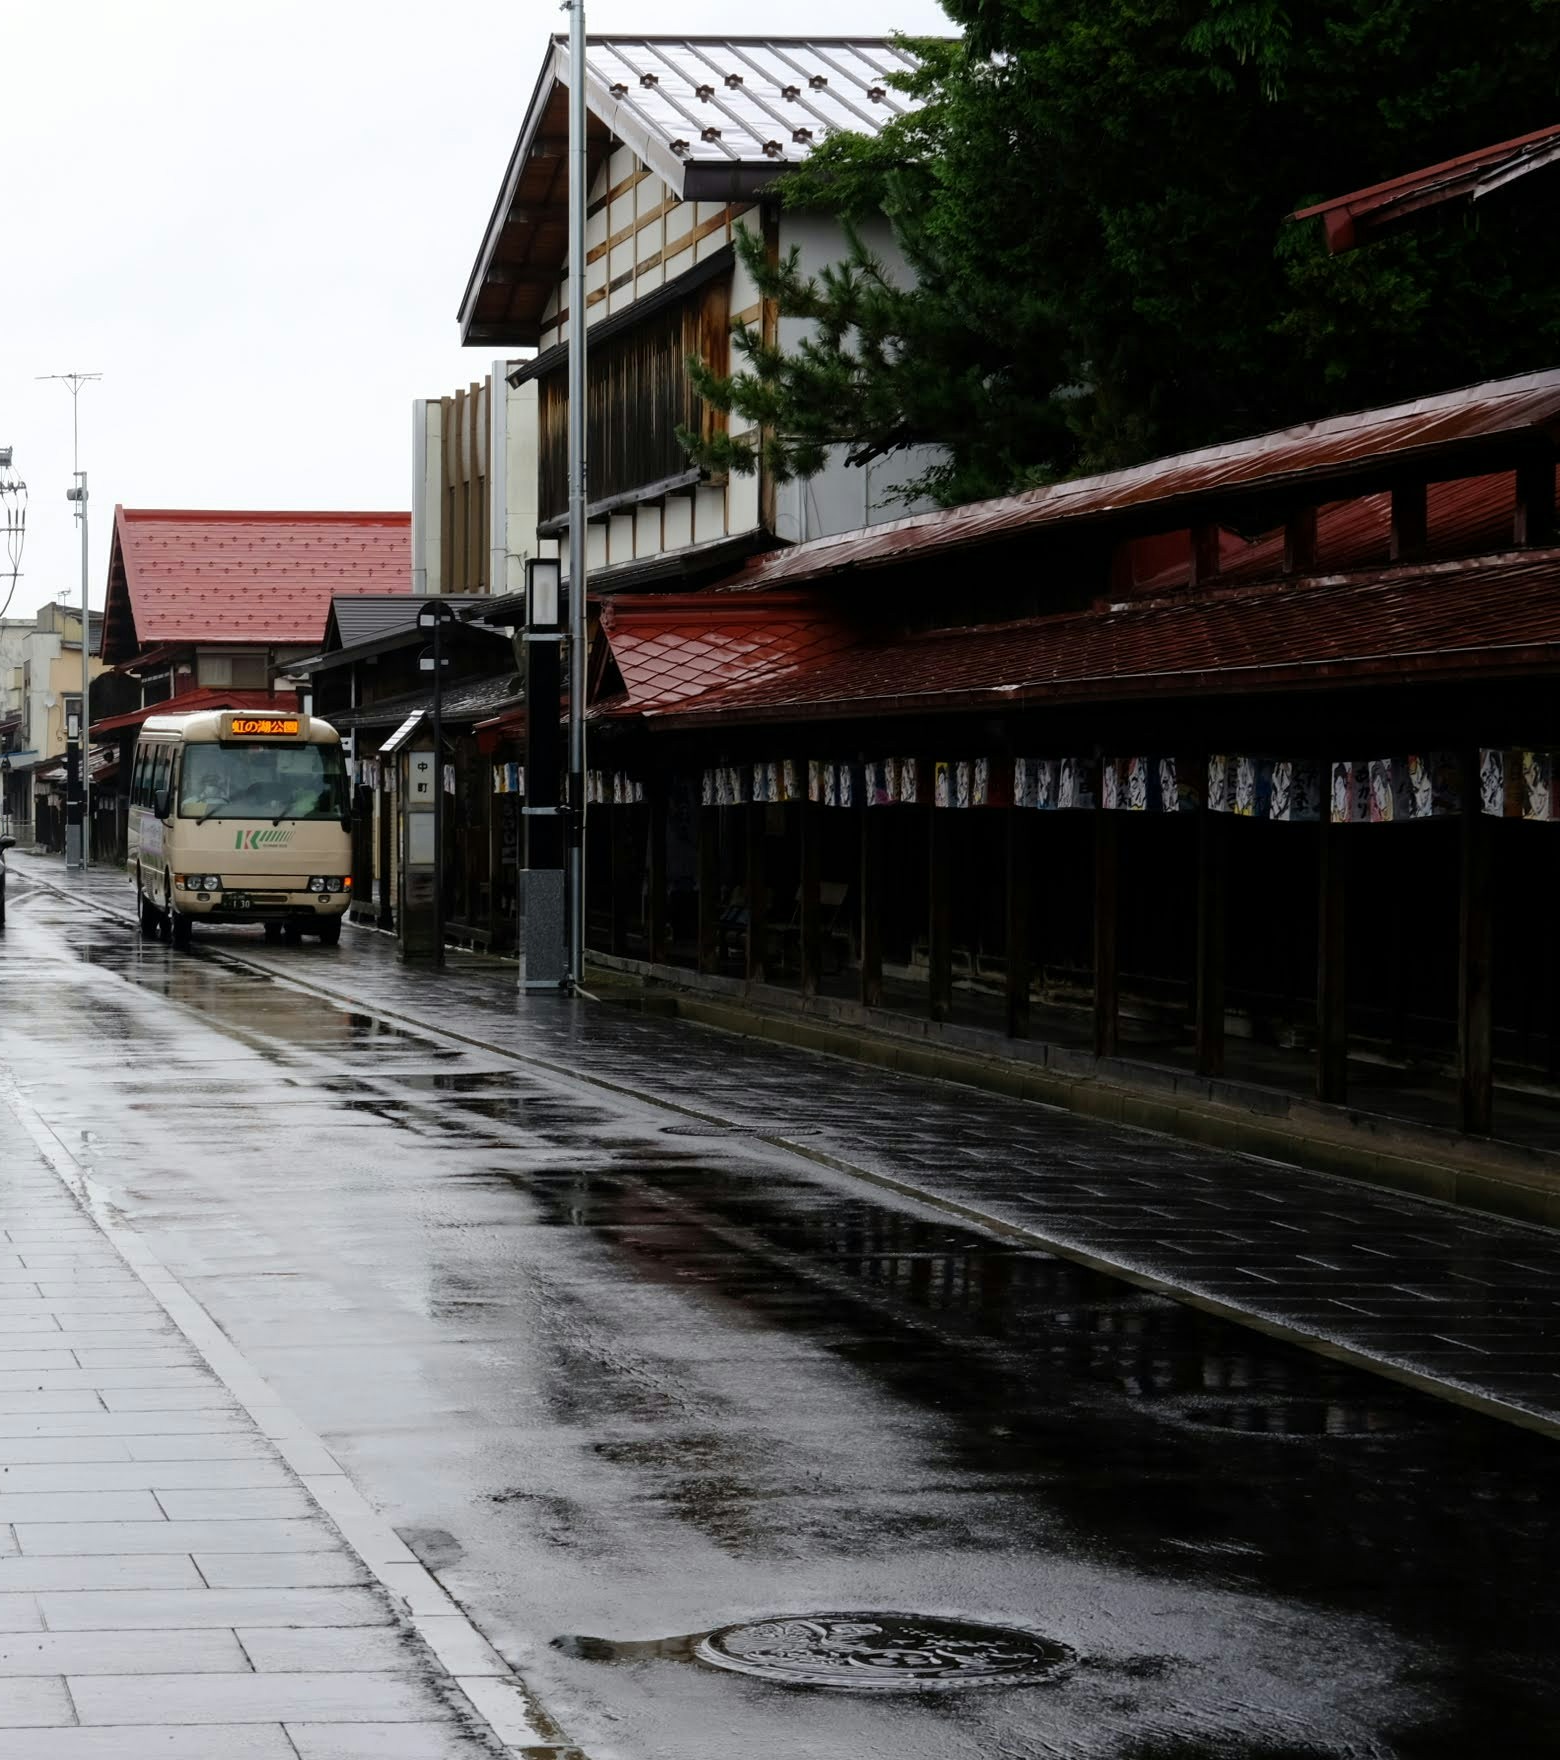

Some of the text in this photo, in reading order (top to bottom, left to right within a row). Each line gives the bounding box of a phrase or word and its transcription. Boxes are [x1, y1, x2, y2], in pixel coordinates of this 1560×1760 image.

[232, 720, 298, 732] 虹の湖公園
[417, 761, 429, 793] 中町
